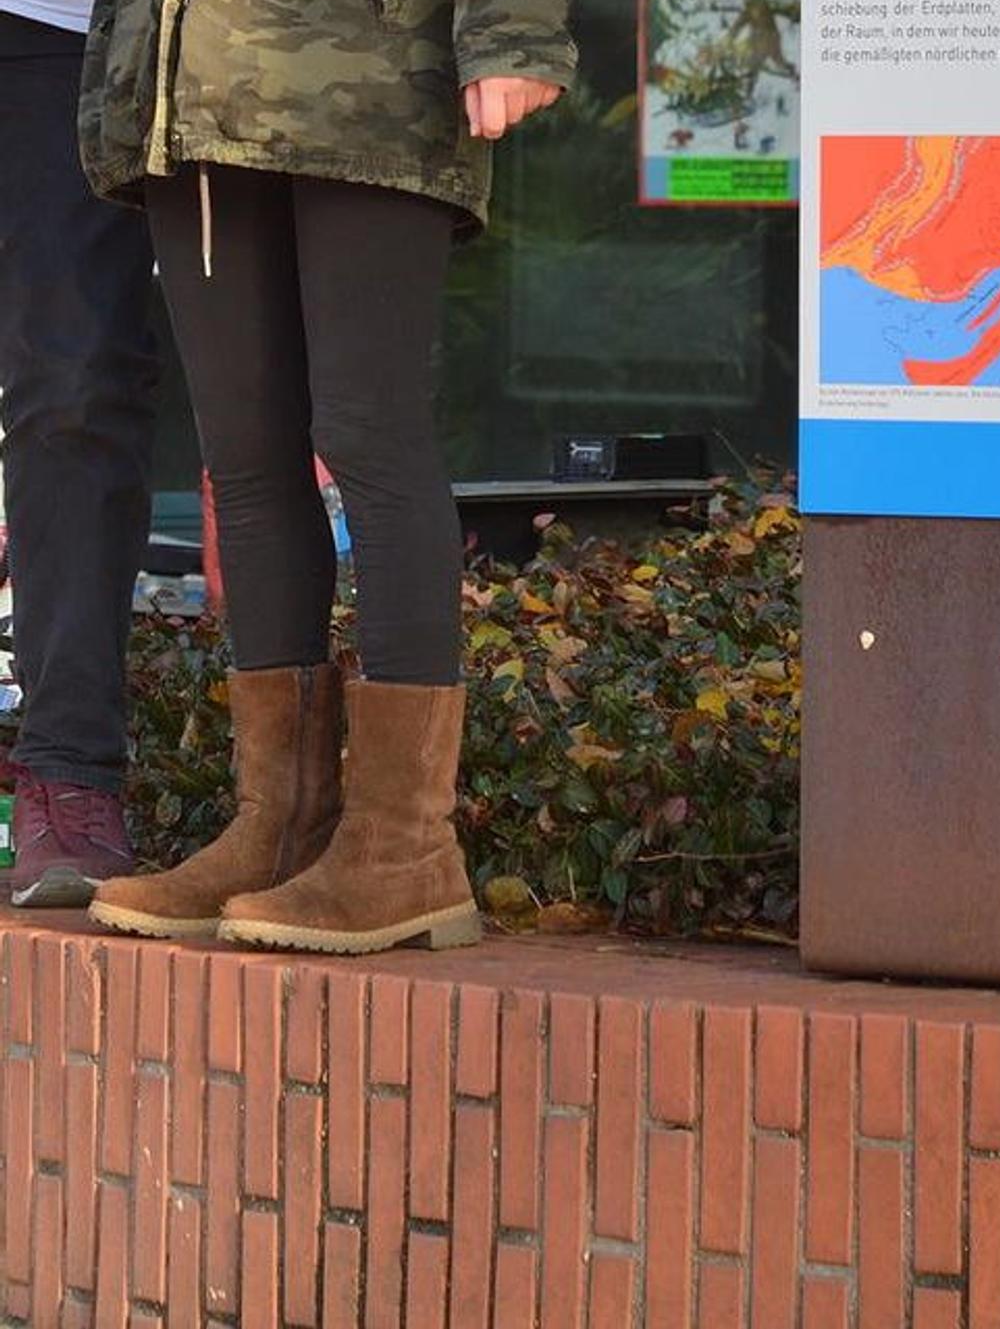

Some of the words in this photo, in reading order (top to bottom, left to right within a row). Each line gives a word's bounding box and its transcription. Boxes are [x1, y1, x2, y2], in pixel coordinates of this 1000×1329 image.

[820, 2, 887, 19] schiebung
[906, 25, 935, 38] dem
[961, 24, 1000, 38] heute
